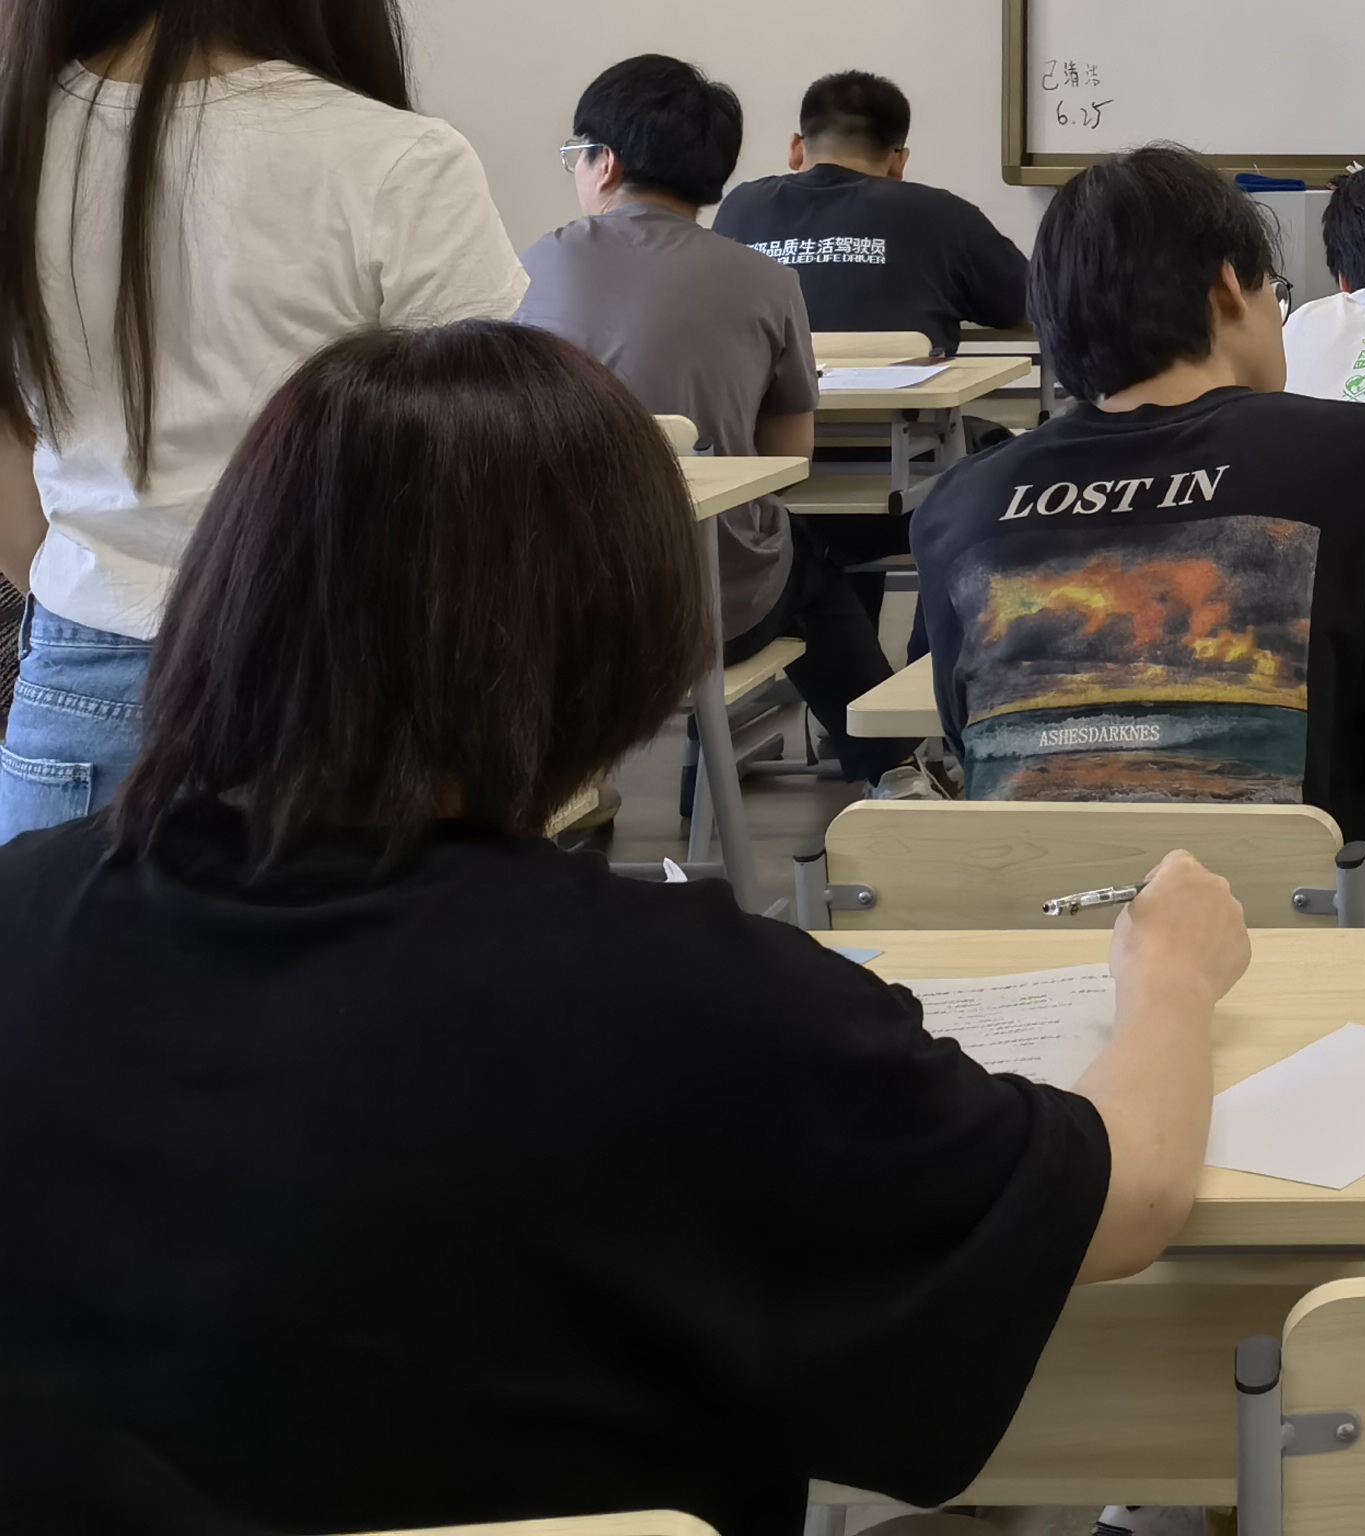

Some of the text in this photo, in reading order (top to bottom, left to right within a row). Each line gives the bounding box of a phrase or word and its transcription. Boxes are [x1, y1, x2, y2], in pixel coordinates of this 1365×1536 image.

[747, 237, 886, 259] 级品质生活驾驶员
[843, 253, 886, 265] DRIVER
[998, 464, 1231, 521] LOST IN
[1038, 724, 1161, 748] ASHESDARKNES
